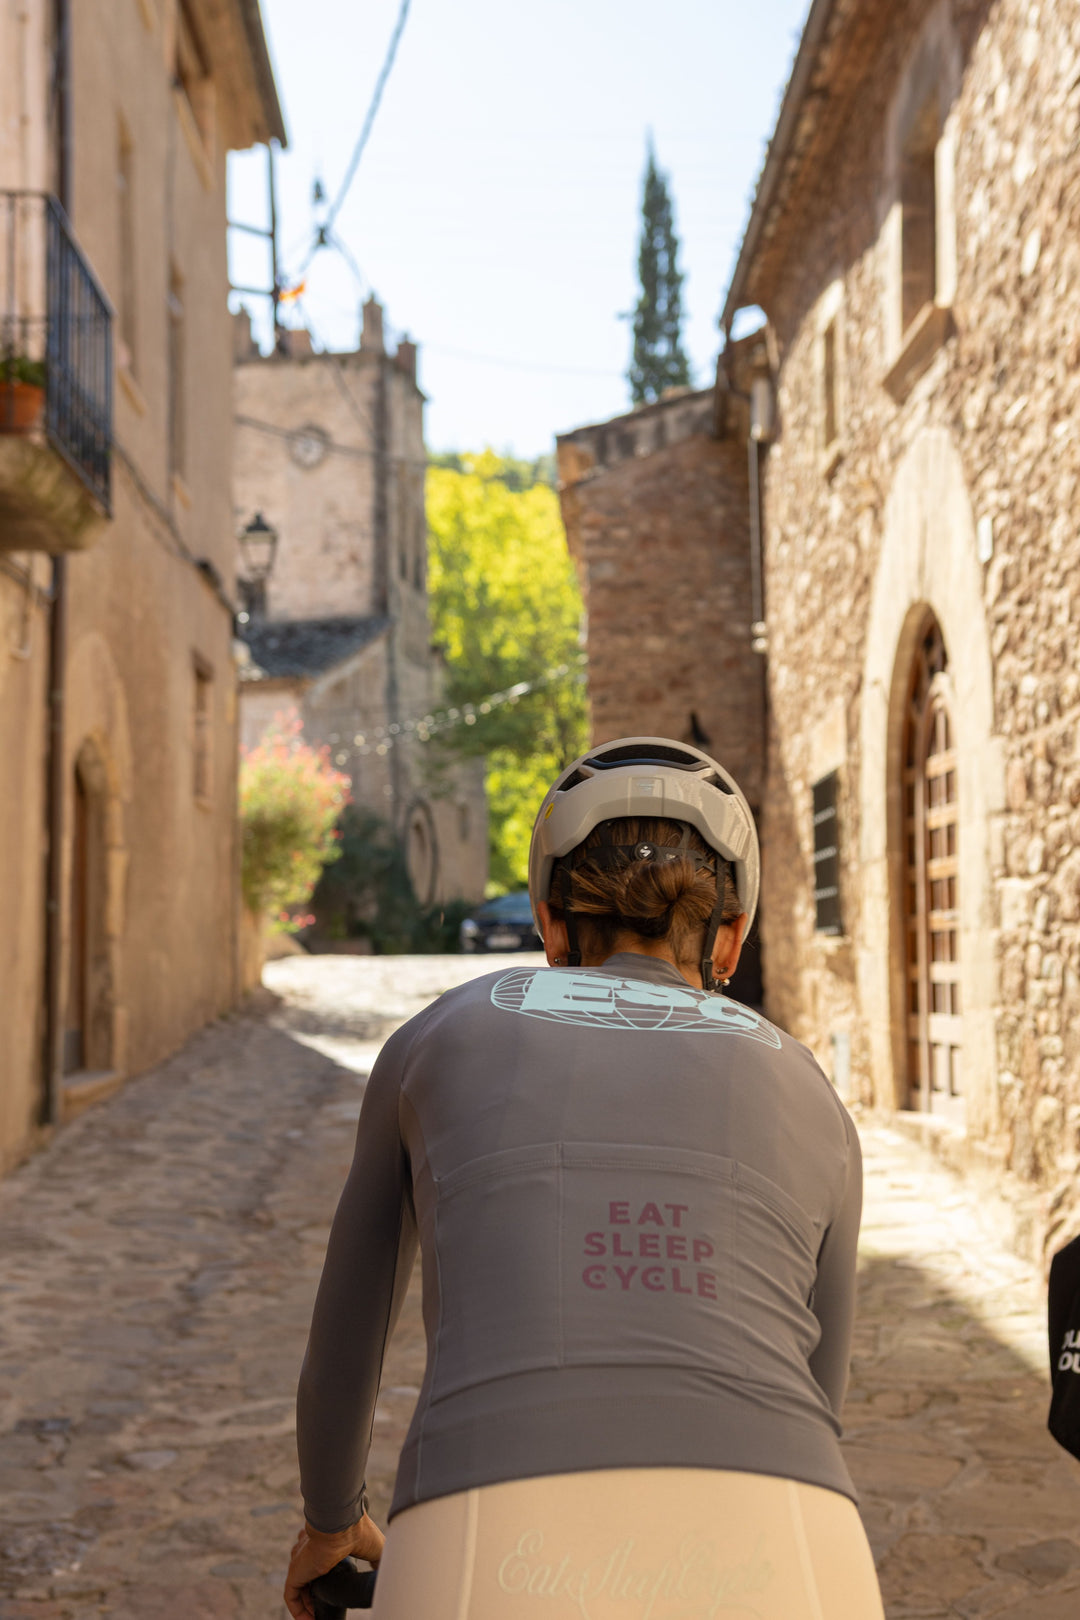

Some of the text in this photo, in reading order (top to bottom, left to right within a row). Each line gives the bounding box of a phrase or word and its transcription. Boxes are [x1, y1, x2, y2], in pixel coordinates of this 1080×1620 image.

[608, 1201, 689, 1229] EAT
[583, 1231, 715, 1263] SLEEP
[582, 1264, 718, 1301] CYCLE
